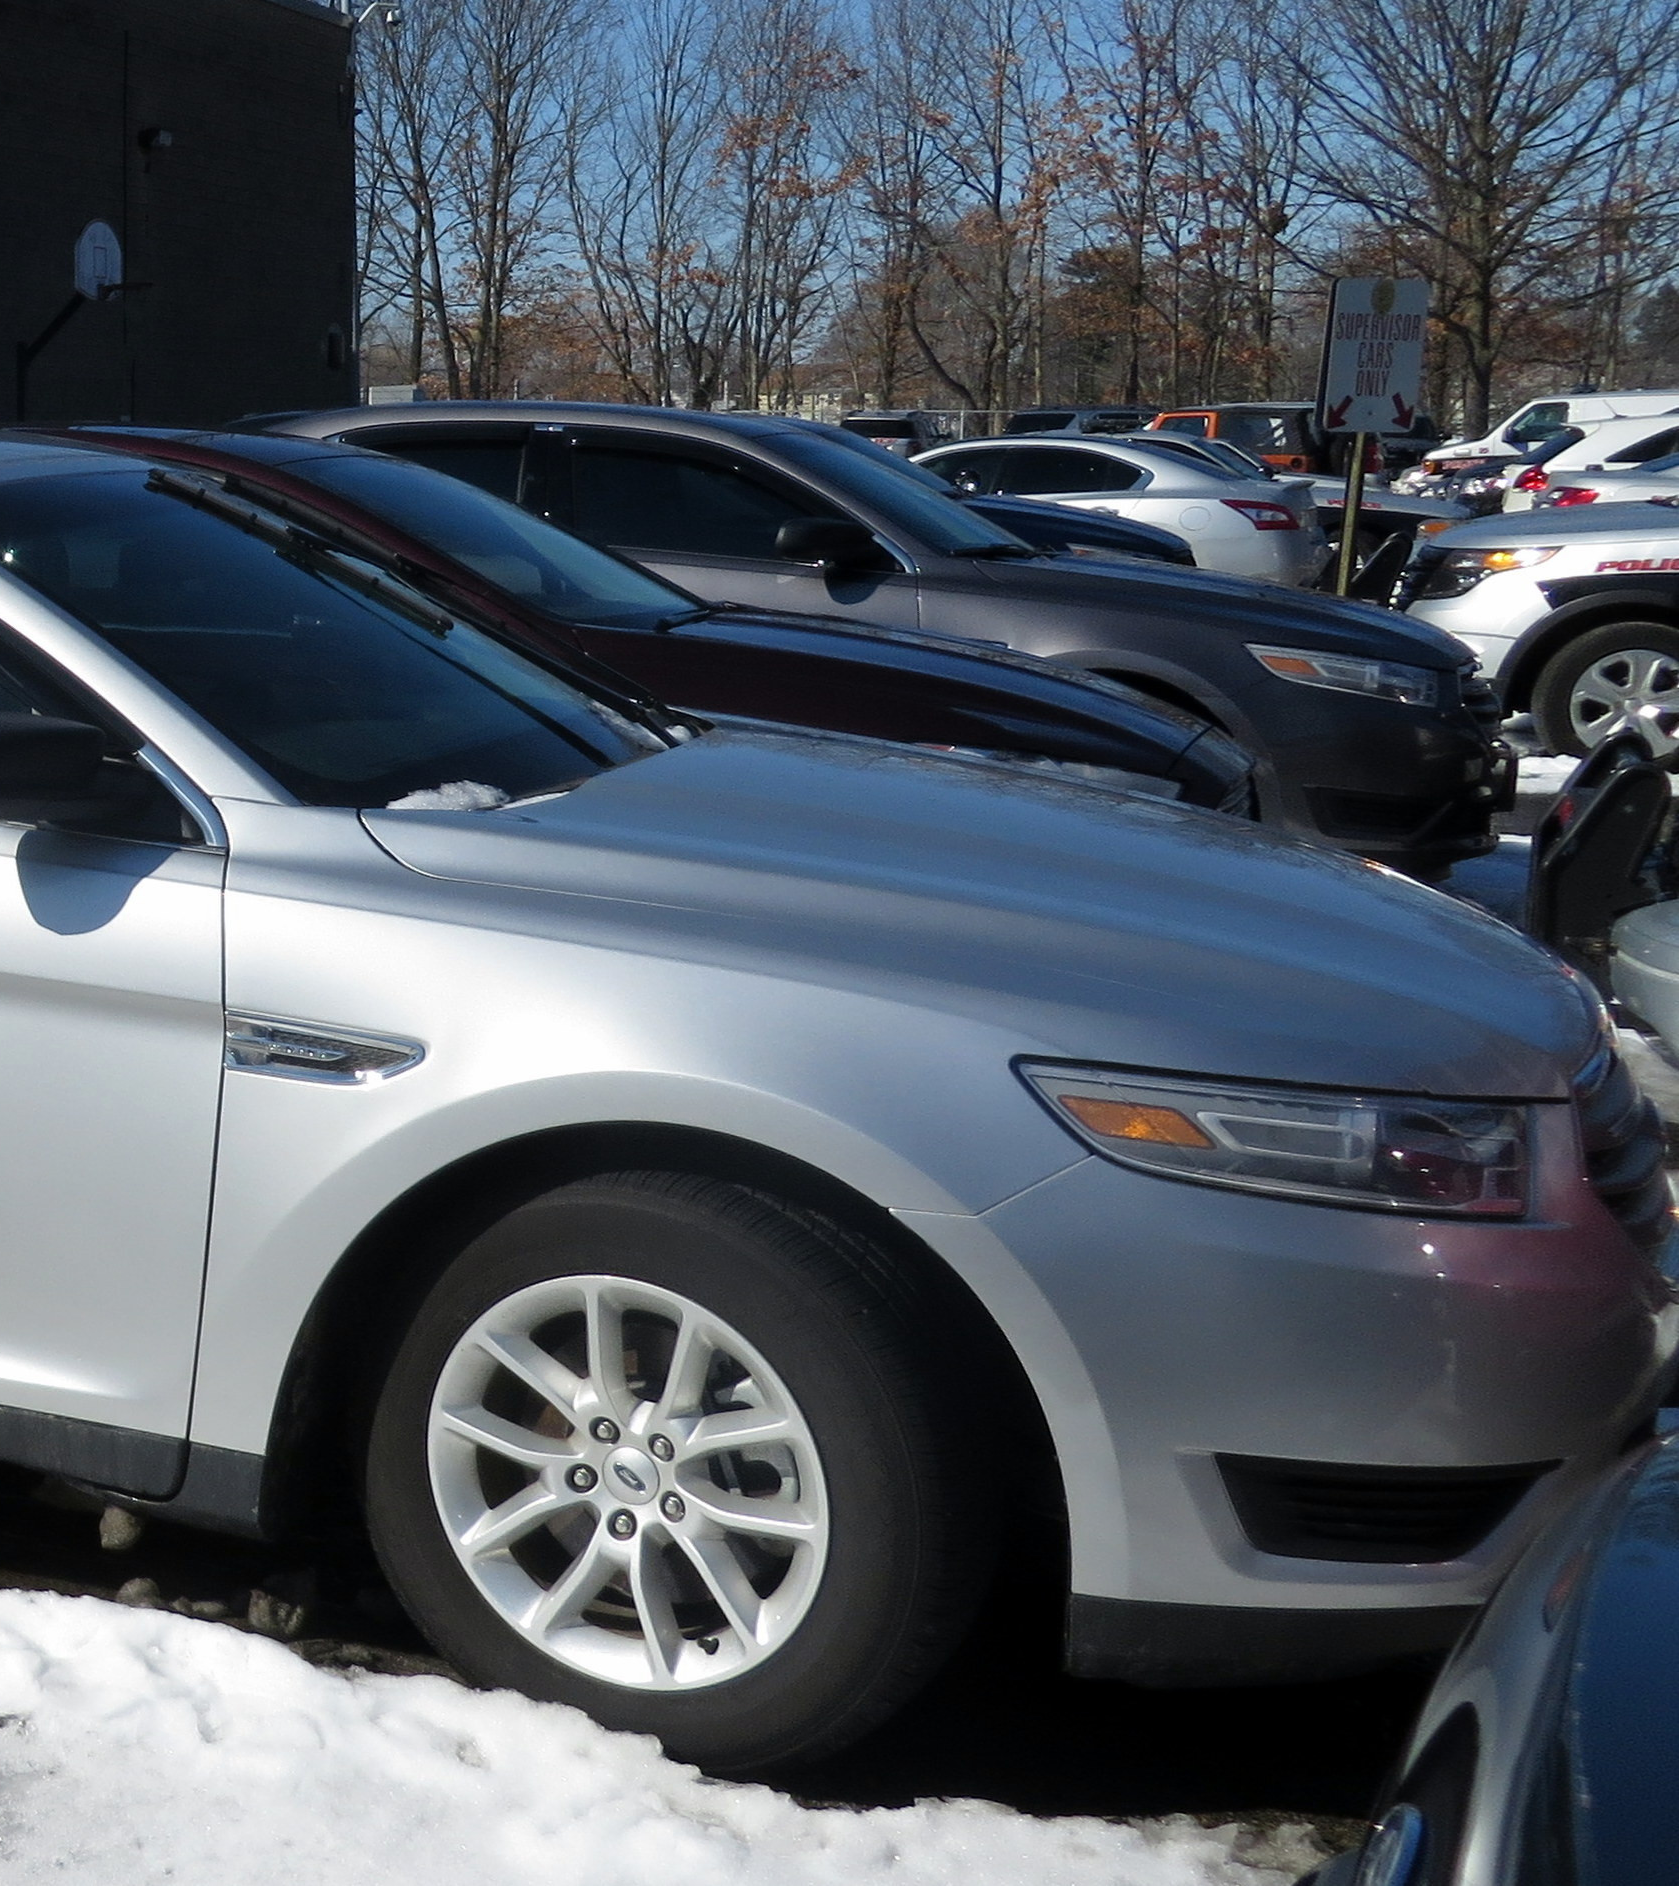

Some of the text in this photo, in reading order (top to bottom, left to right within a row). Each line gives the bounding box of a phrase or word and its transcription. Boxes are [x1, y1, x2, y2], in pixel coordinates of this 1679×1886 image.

[1335, 312, 1421, 341] SUPERVISOR
[1356, 342, 1394, 369] CARS
[1355, 370, 1390, 397] ONLY
